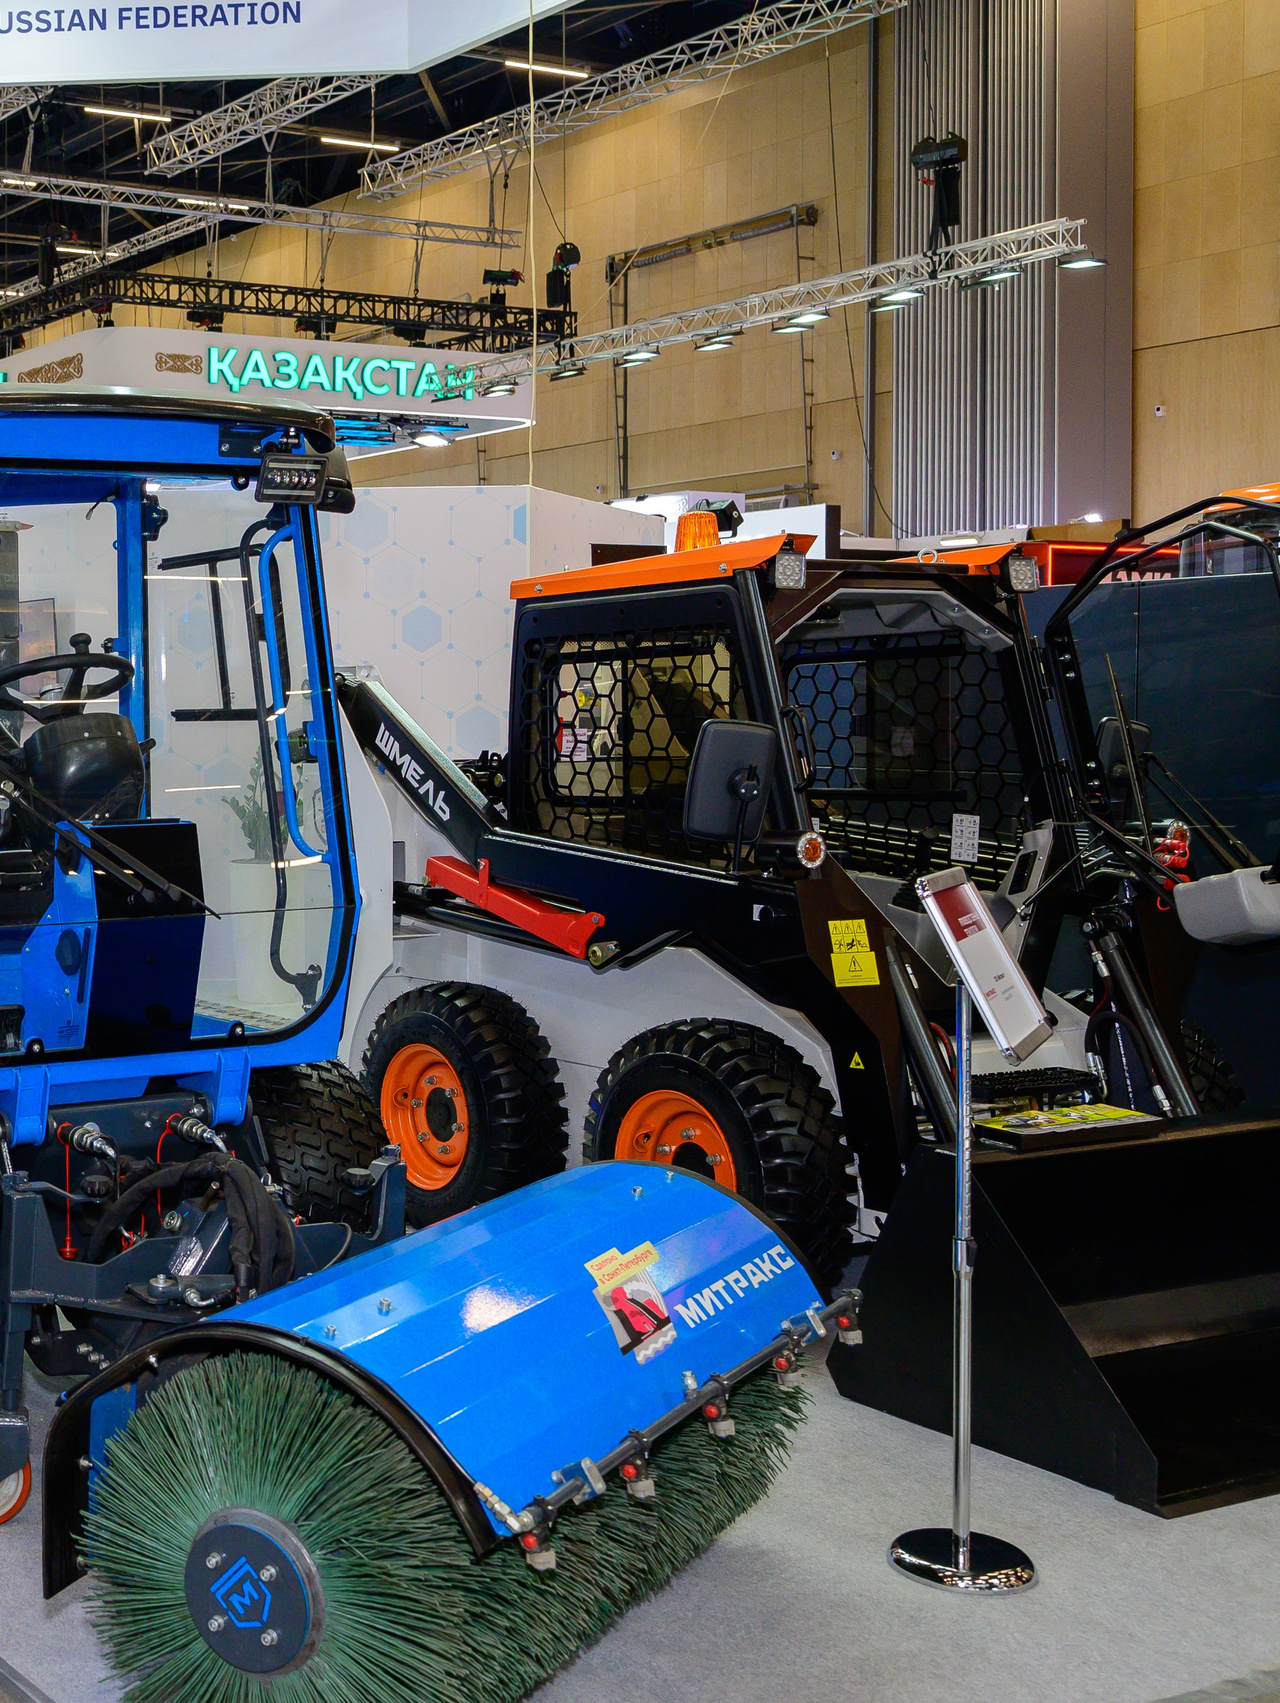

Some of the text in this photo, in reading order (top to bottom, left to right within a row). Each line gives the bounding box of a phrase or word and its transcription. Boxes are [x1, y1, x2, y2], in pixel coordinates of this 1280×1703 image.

[118, 1, 302, 30] FEDERATION
[375, 722, 450, 822] ШМЕЛЬ
[590, 1254, 618, 1271] Сделано
[602, 1249, 653, 1282] Санкт-Петербурге
[673, 1244, 795, 1329] МИТРАКС
